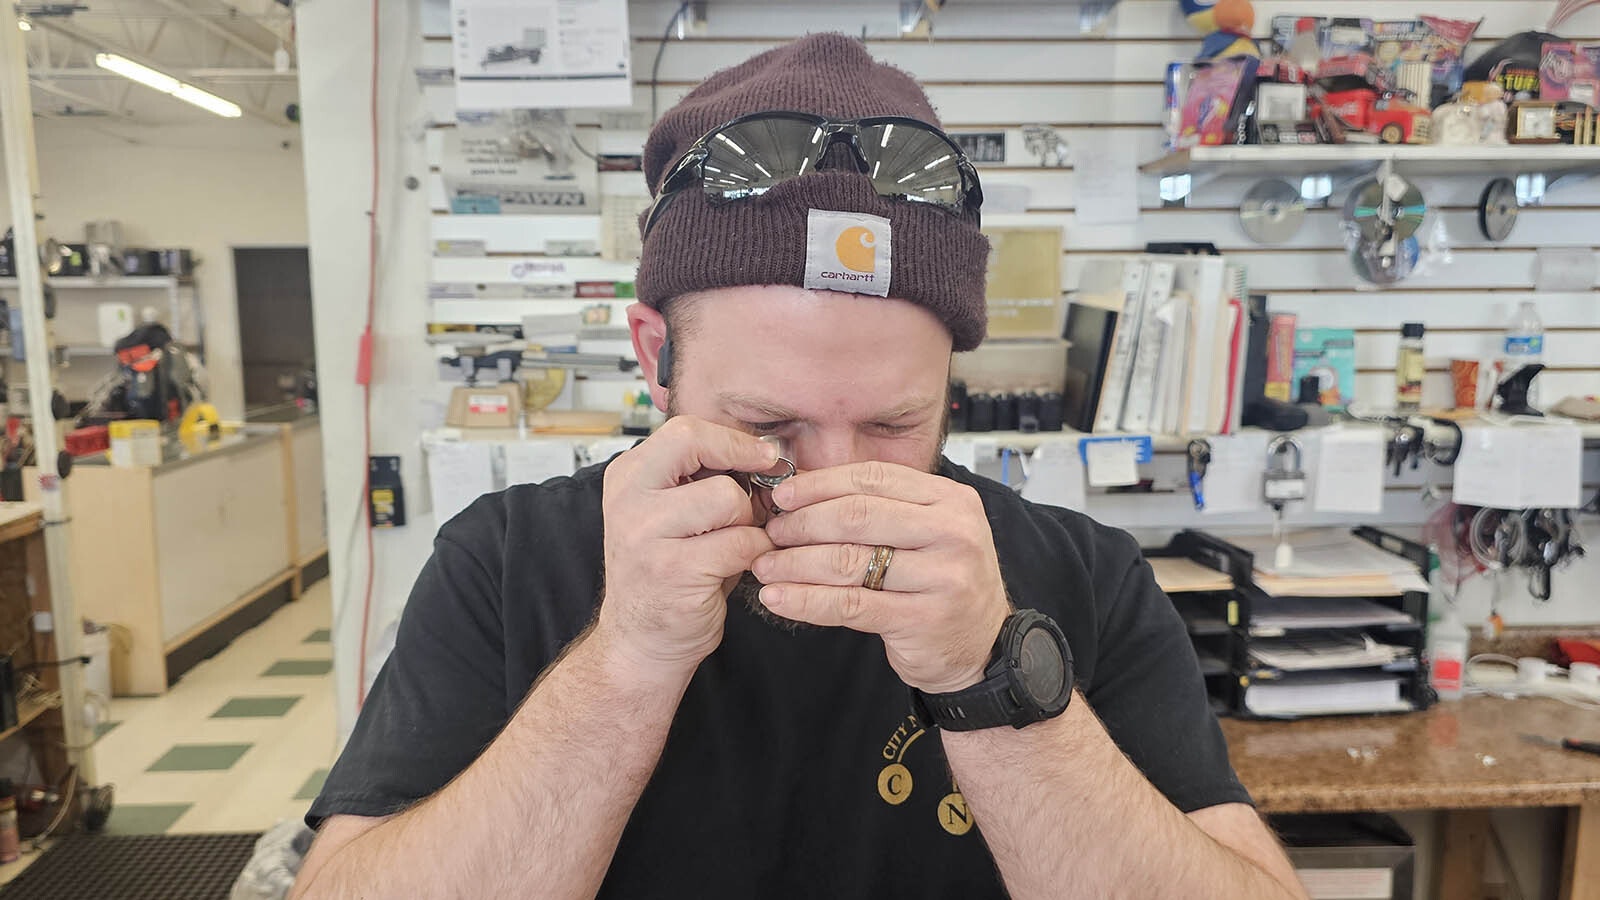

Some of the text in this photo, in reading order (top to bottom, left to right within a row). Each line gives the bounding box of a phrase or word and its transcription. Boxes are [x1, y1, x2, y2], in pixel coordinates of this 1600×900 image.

[820, 271, 875, 282] carhartt
[882, 722, 908, 760] CITY
[887, 774, 902, 795] C
[946, 802, 968, 825] N
